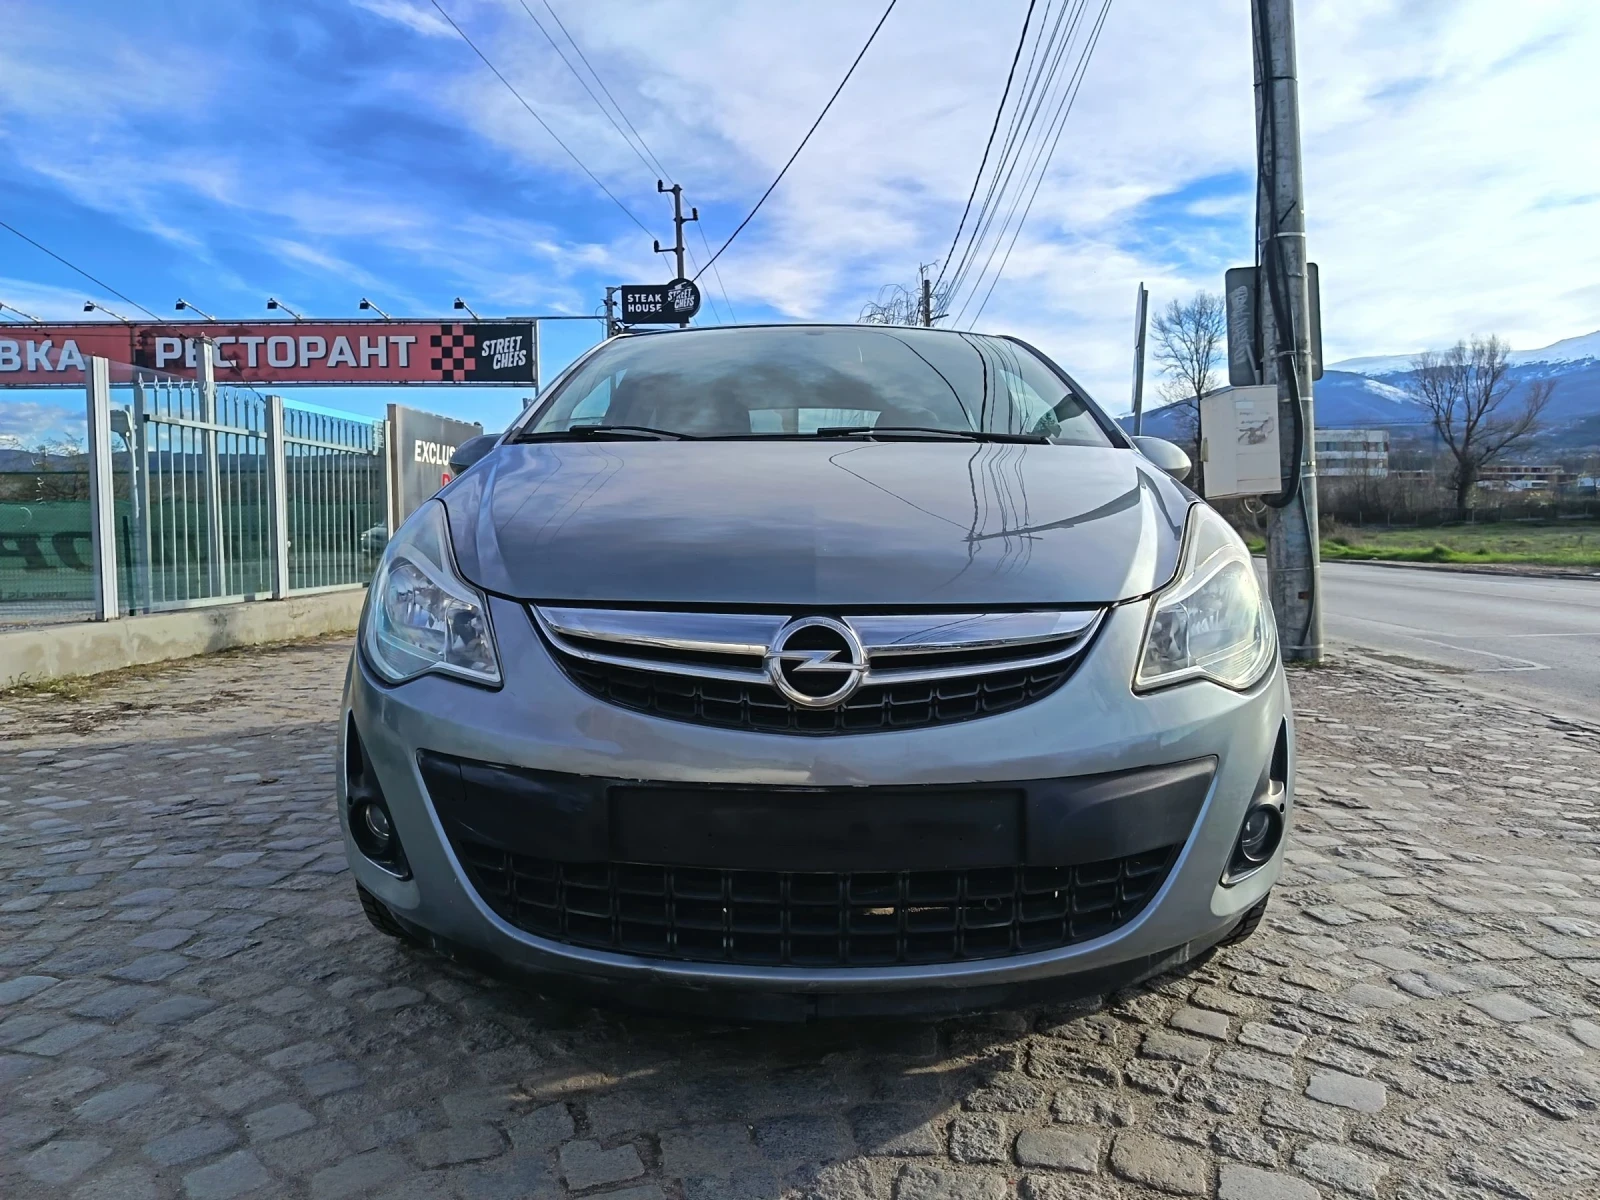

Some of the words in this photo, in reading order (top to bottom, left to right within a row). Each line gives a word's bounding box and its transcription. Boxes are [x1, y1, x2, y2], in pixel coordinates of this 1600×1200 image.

[627, 294, 662, 302] STEAK
[667, 288, 692, 301] STREET
[628, 303, 662, 312] HOUSE
[674, 296, 695, 309] CHEFS
[481, 336, 523, 357] STREET
[492, 349, 527, 370] CHEFS
